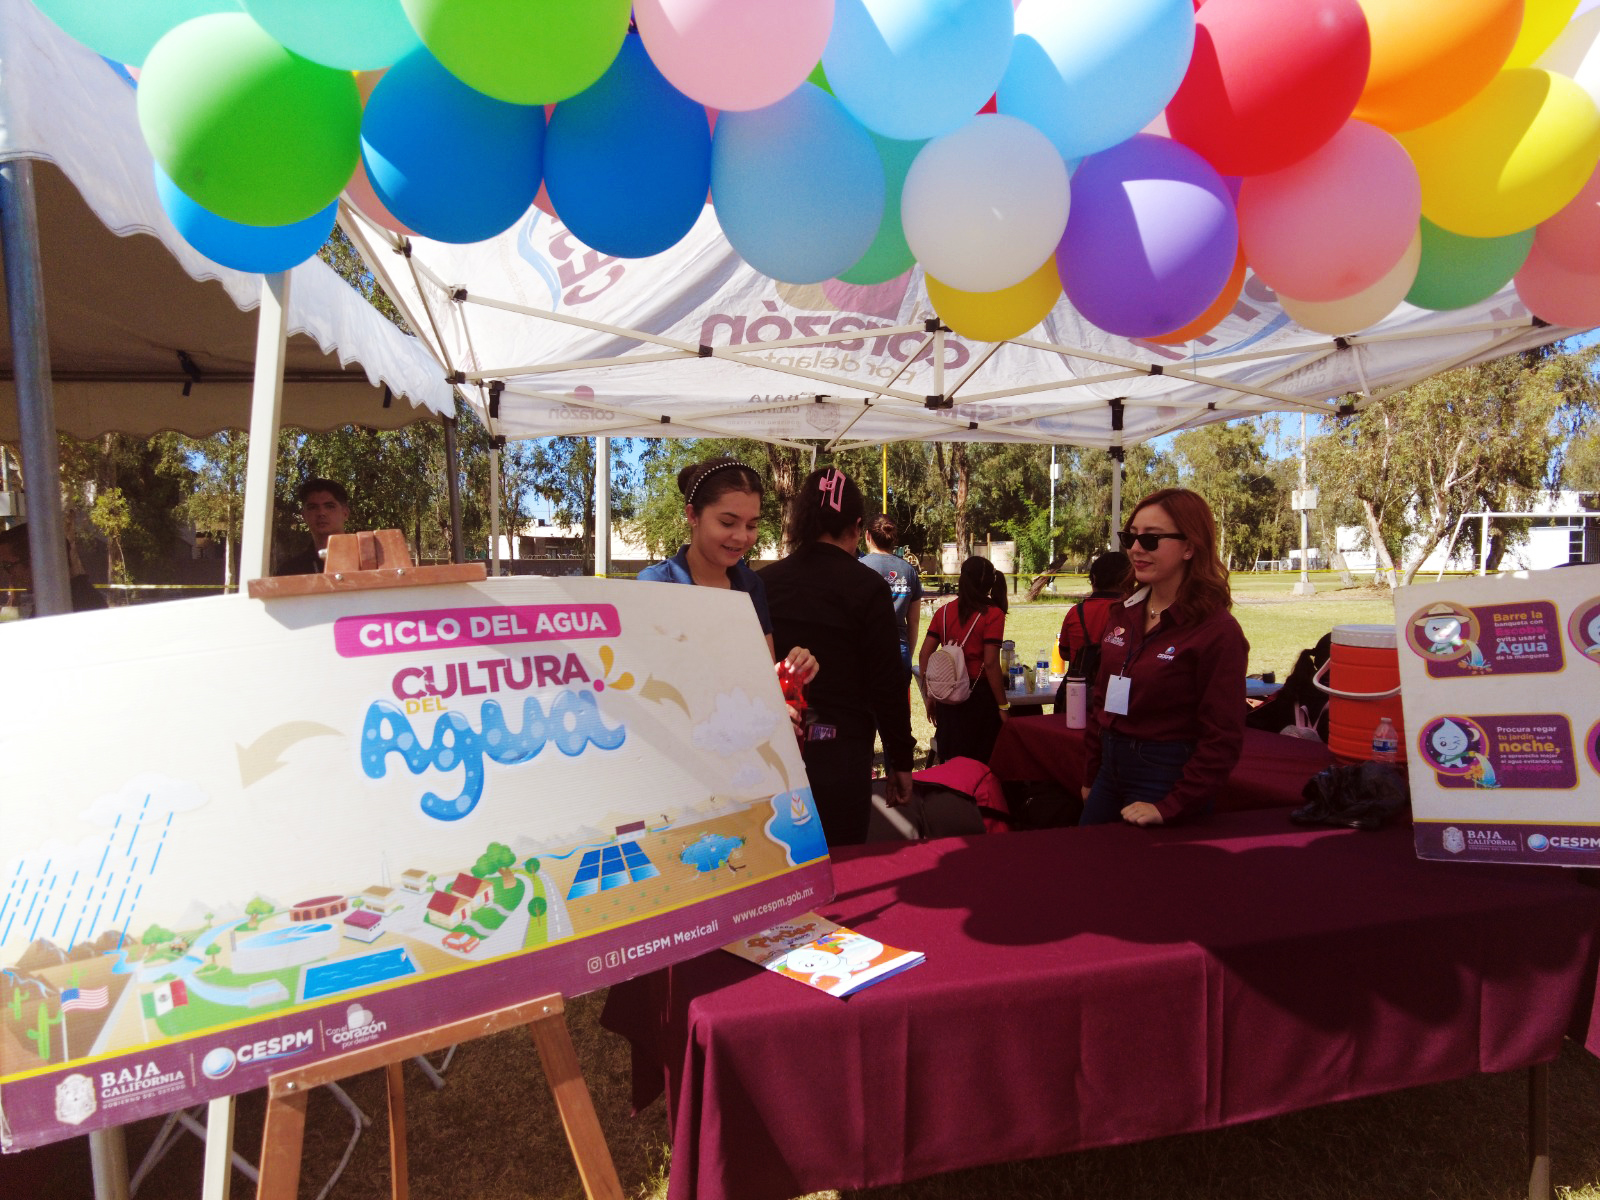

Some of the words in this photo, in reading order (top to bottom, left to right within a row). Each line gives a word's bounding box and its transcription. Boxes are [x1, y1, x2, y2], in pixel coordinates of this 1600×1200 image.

[1493, 612, 1528, 622] Barre
[1531, 610, 1543, 619] la
[1494, 620, 1529, 628] banqueta
[359, 617, 461, 648] CICLO
[470, 614, 528, 638] DEL
[535, 611, 607, 634] AGUA
[1496, 635, 1517, 643] evita
[1495, 641, 1549, 656] Agua
[392, 653, 591, 701] CULTURA
[405, 696, 448, 715] DEL
[1532, 726, 1557, 734] regar
[360, 689, 627, 822] Agua
[1498, 739, 1561, 755] noche,
[1467, 831, 1502, 839] BAJA
[1550, 836, 1600, 848] CESPM
[733, 886, 814, 925] www.cespm.gob.mx
[627, 936, 671, 960] CESPM
[674, 919, 719, 945] Mexicali
[325, 1027, 341, 1036] Con
[341, 1024, 348, 1032] el
[332, 1020, 387, 1044] corazón
[236, 1028, 313, 1063] CESPM
[100, 1061, 161, 1089] BAJA
[101, 1070, 185, 1098] CALIFORNIA
